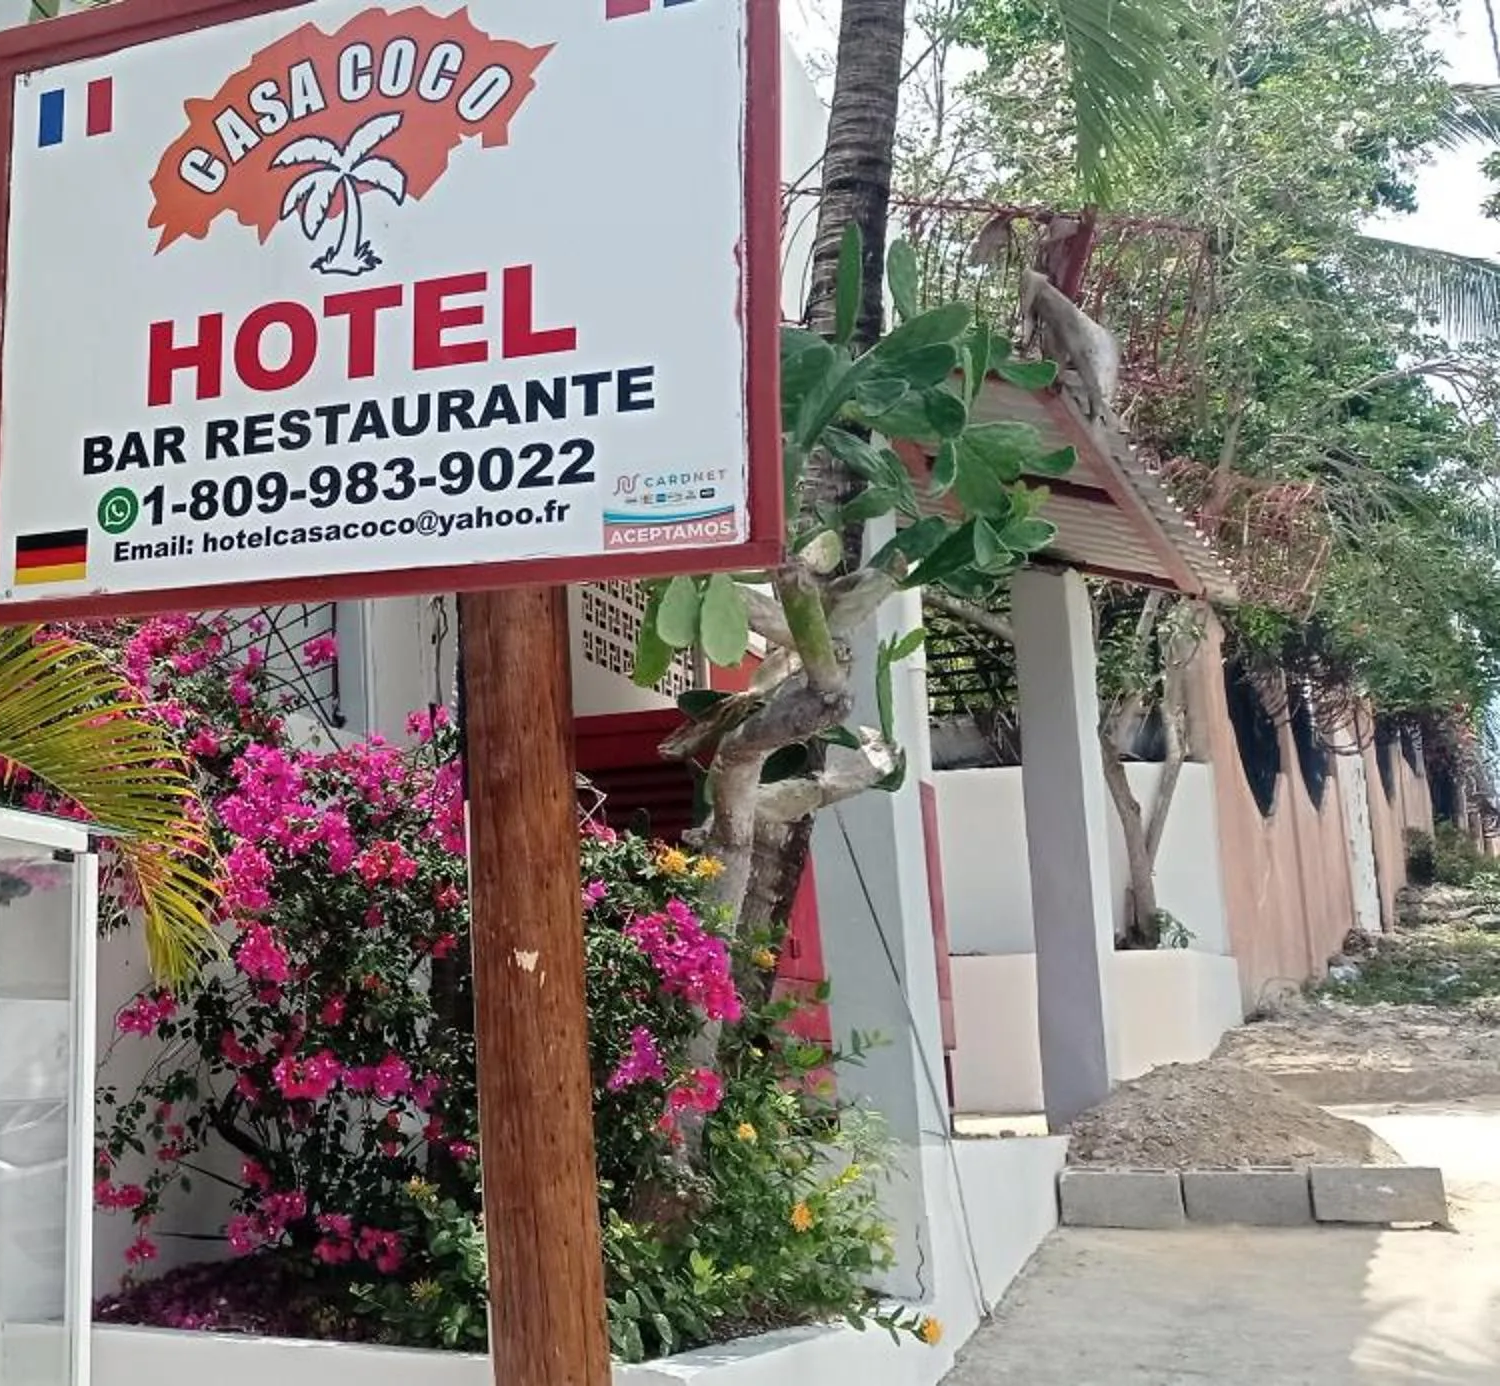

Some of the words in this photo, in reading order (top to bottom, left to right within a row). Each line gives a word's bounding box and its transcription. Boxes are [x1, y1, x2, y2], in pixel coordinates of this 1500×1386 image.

[178, 57, 327, 194] CASA
[337, 36, 513, 122] COCO
[147, 264, 577, 407] HOTEL
[83, 426, 186, 475] BAR
[205, 365, 655, 460] RESTAURANTE
[141, 438, 595, 527] 1-809-983-9022
[644, 469, 727, 488] CARDNET
[113, 534, 194, 563] Email:
[202, 499, 571, 555] hotelcasacoco@yahoo.fr
[609, 520, 732, 545] ACEPTAMOS
